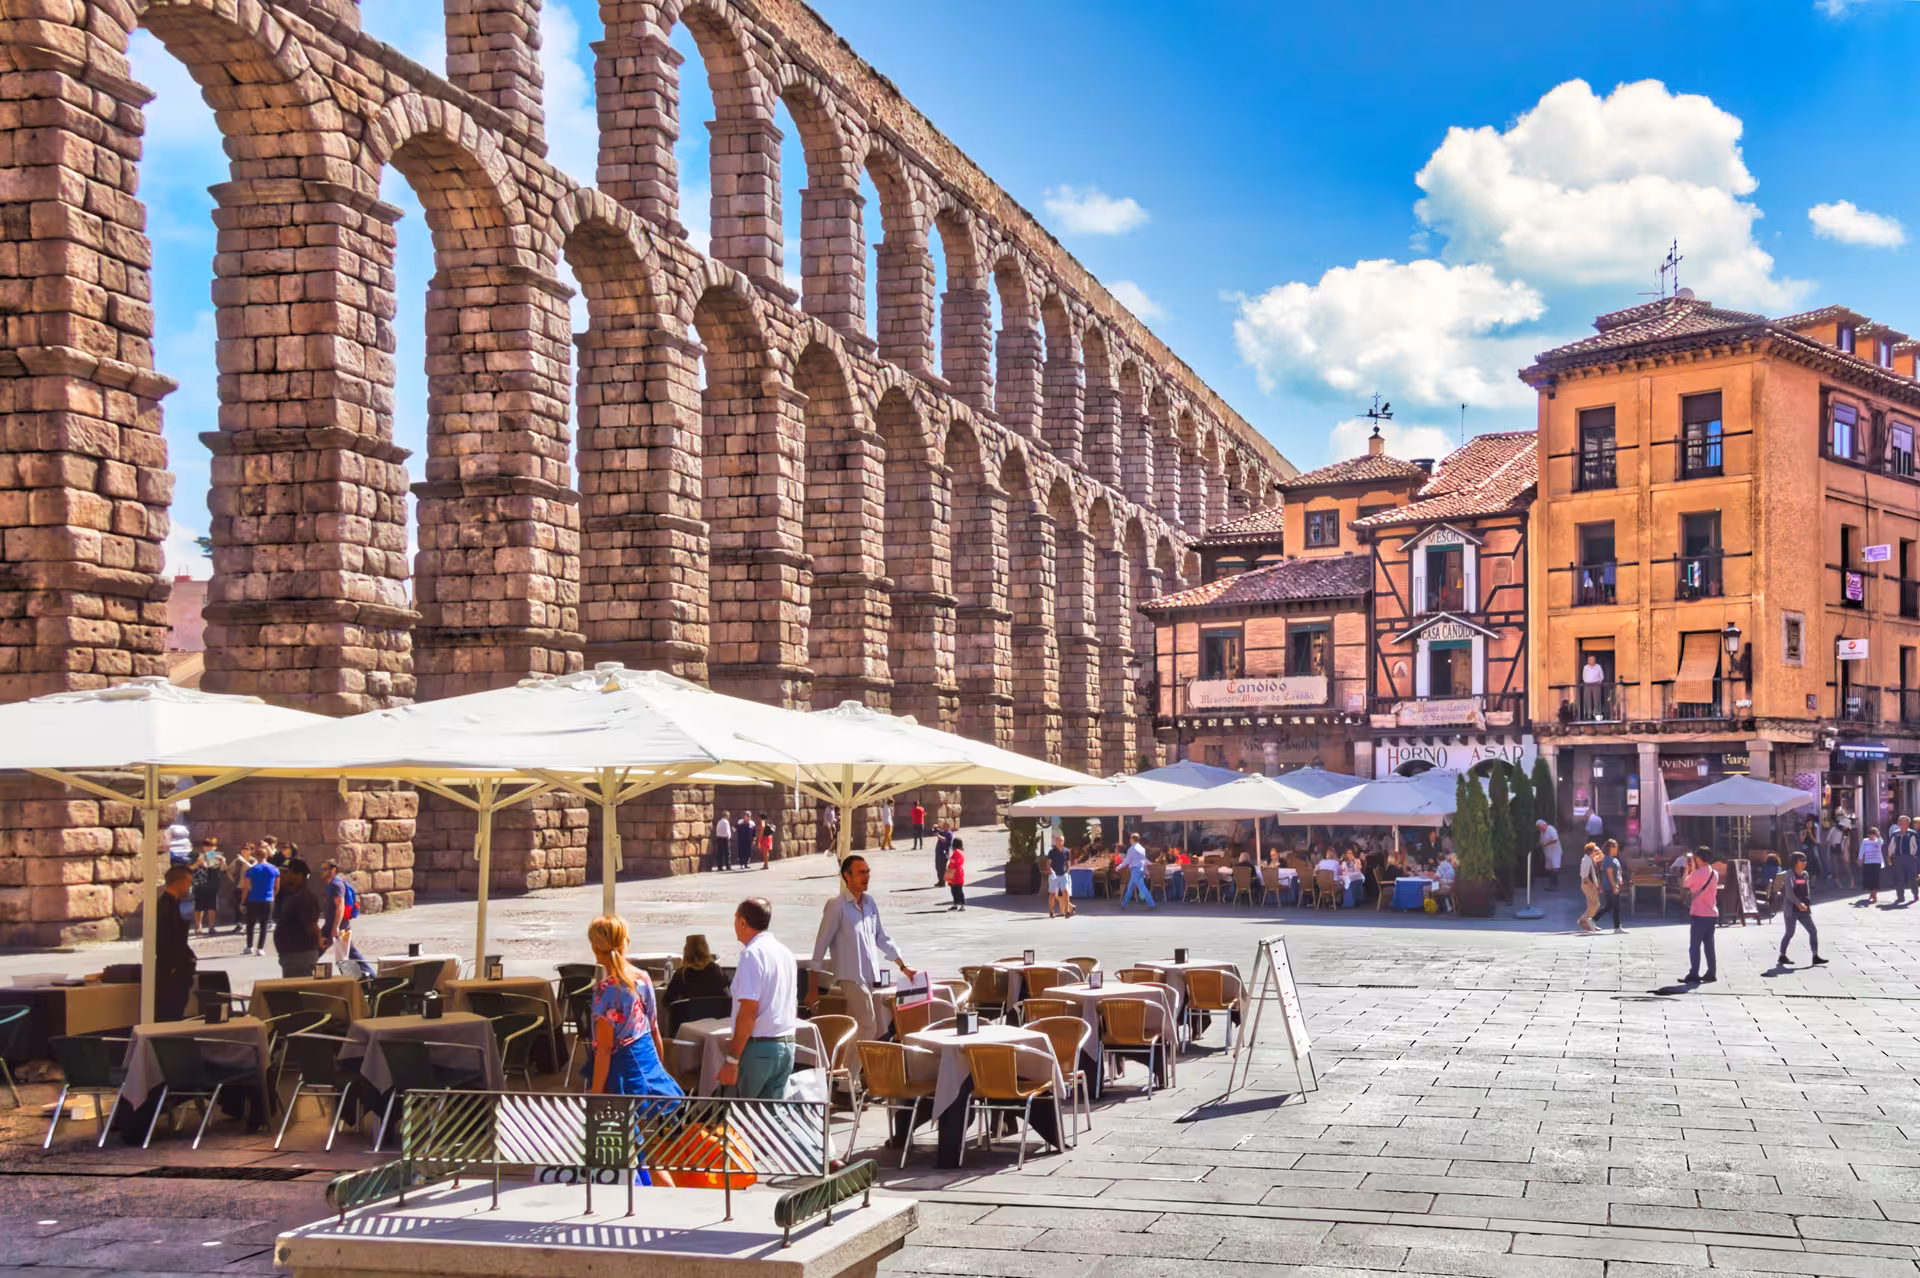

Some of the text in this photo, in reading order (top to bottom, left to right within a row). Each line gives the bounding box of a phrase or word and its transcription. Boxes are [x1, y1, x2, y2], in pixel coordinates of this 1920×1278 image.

[1428, 530, 1460, 544] MESON
[1422, 624, 1476, 640] CASA CANDIDO
[1228, 680, 1287, 694] Candido
[1388, 747, 1448, 775] HORNO
